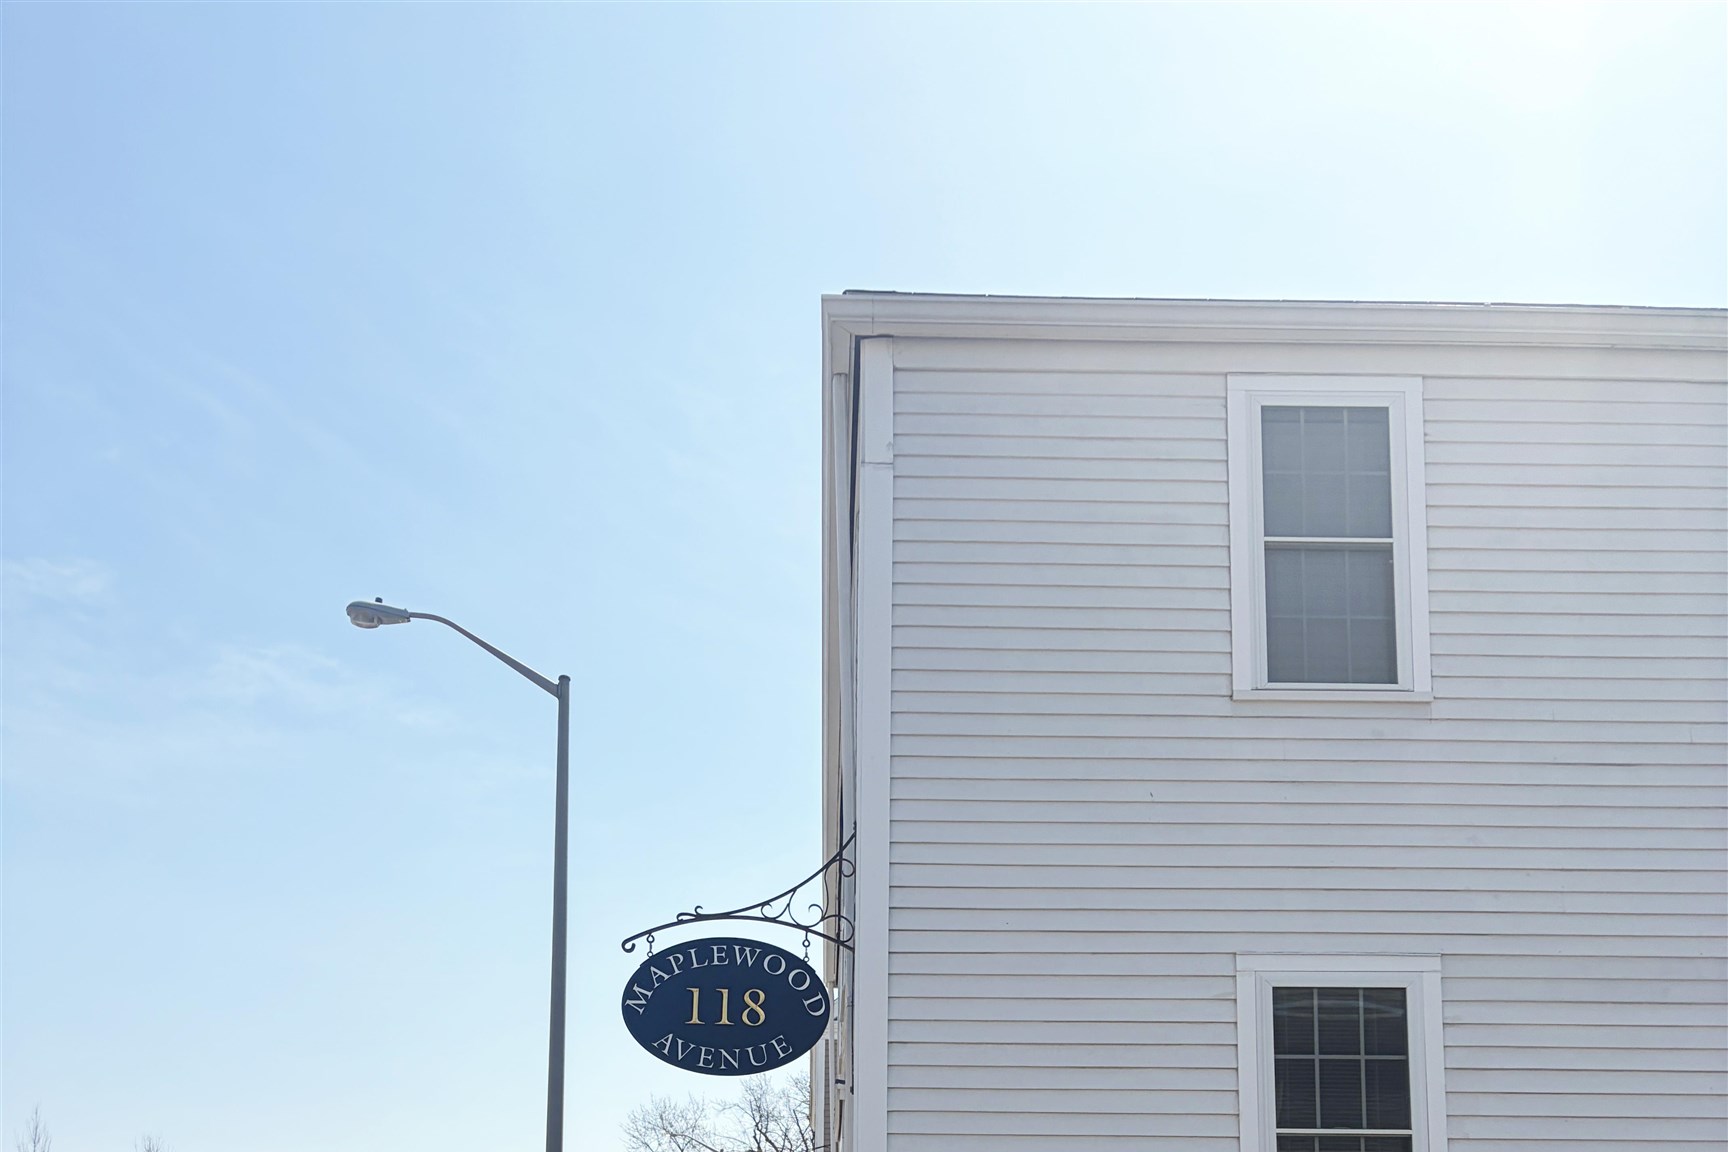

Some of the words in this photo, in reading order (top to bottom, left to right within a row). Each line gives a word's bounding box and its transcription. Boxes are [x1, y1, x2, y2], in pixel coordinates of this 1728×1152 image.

[625, 945, 826, 1018] MAPLEWOOD
[685, 987, 767, 1026] 118
[652, 1033, 793, 1070] AVENUE
